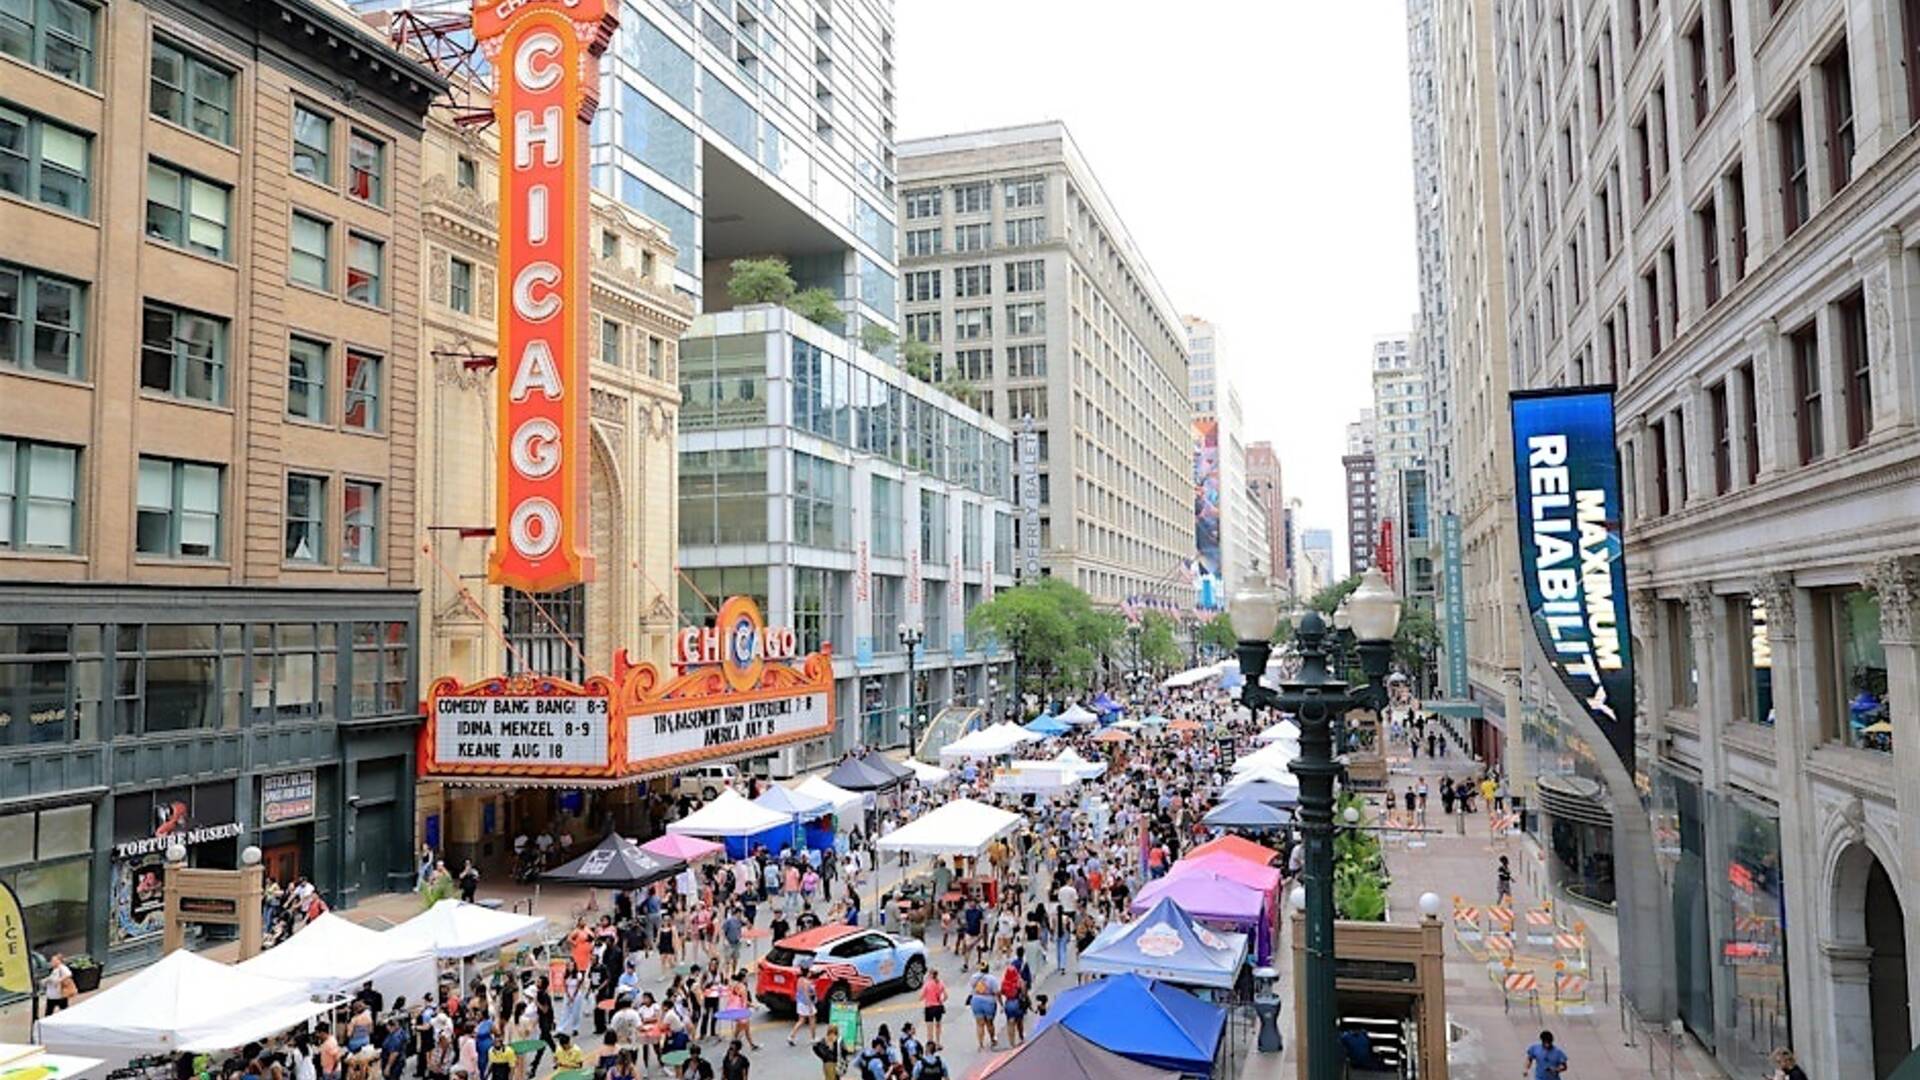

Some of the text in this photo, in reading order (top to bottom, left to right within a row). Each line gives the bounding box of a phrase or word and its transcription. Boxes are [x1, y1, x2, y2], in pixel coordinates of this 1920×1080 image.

[510, 32, 565, 559] CHICAGO
[1528, 434, 1617, 722] RELIABILITY
[1576, 489, 1622, 670] MAXIMUM
[682, 625, 797, 663] CHICAGO
[438, 700, 486, 714] COMEDY
[493, 700, 529, 714] BANG
[536, 700, 576, 714] BANG!
[457, 721, 590, 736] IDINA MENZEL 8-9
[458, 743, 563, 758] KEANE AUG 18
[116, 822, 245, 857] TORTURE MUSEUM
[5, 914, 18, 956] ICE
